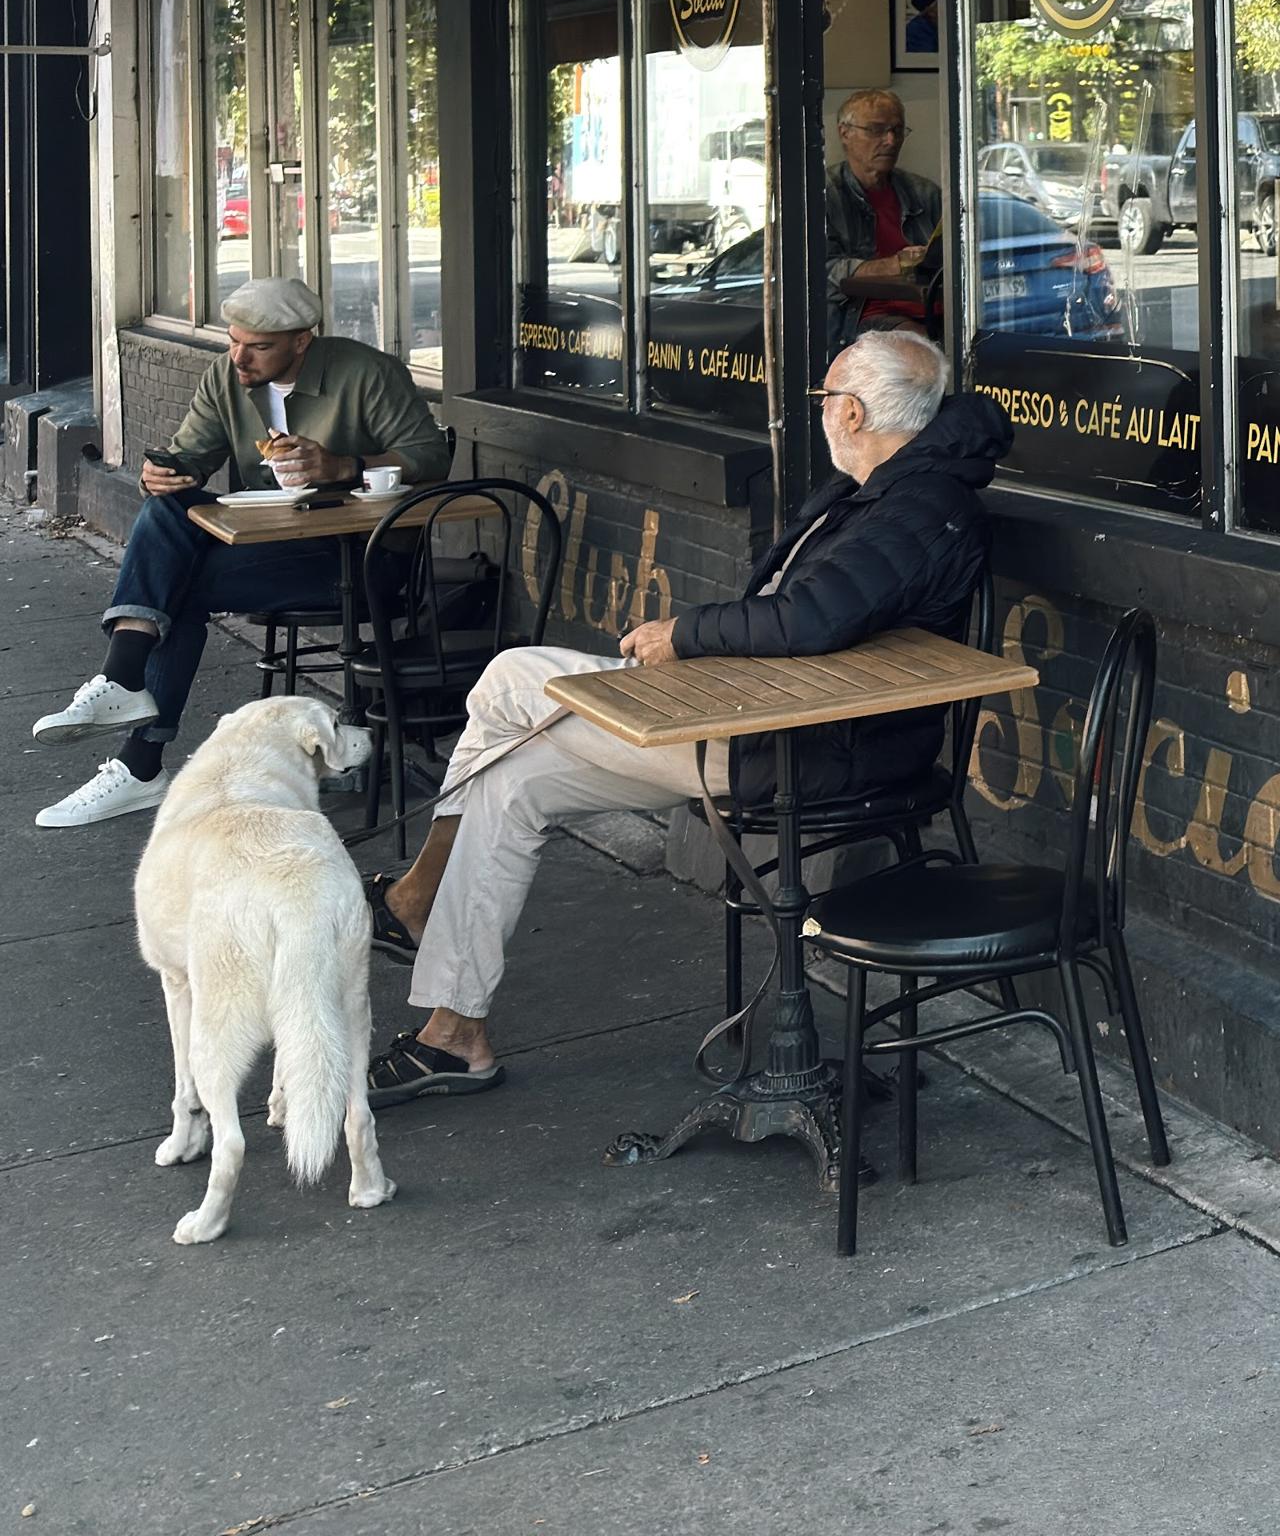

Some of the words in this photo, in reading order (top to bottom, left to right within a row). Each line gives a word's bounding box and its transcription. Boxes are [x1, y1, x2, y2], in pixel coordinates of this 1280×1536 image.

[520, 323, 559, 351] ESPRESSO
[568, 325, 592, 356] CAFÉ
[592, 329, 606, 358] AU
[607, 331, 623, 361] LAI
[648, 341, 681, 371] PANINI
[700, 344, 729, 378] CAFÉ
[731, 353, 747, 381] AU
[749, 354, 767, 384] LA
[975, 384, 1054, 428] RESSO
[1075, 394, 1123, 439] CAFÉ
[1125, 405, 1153, 444] AU
[1157, 409, 1200, 451] LAIT
